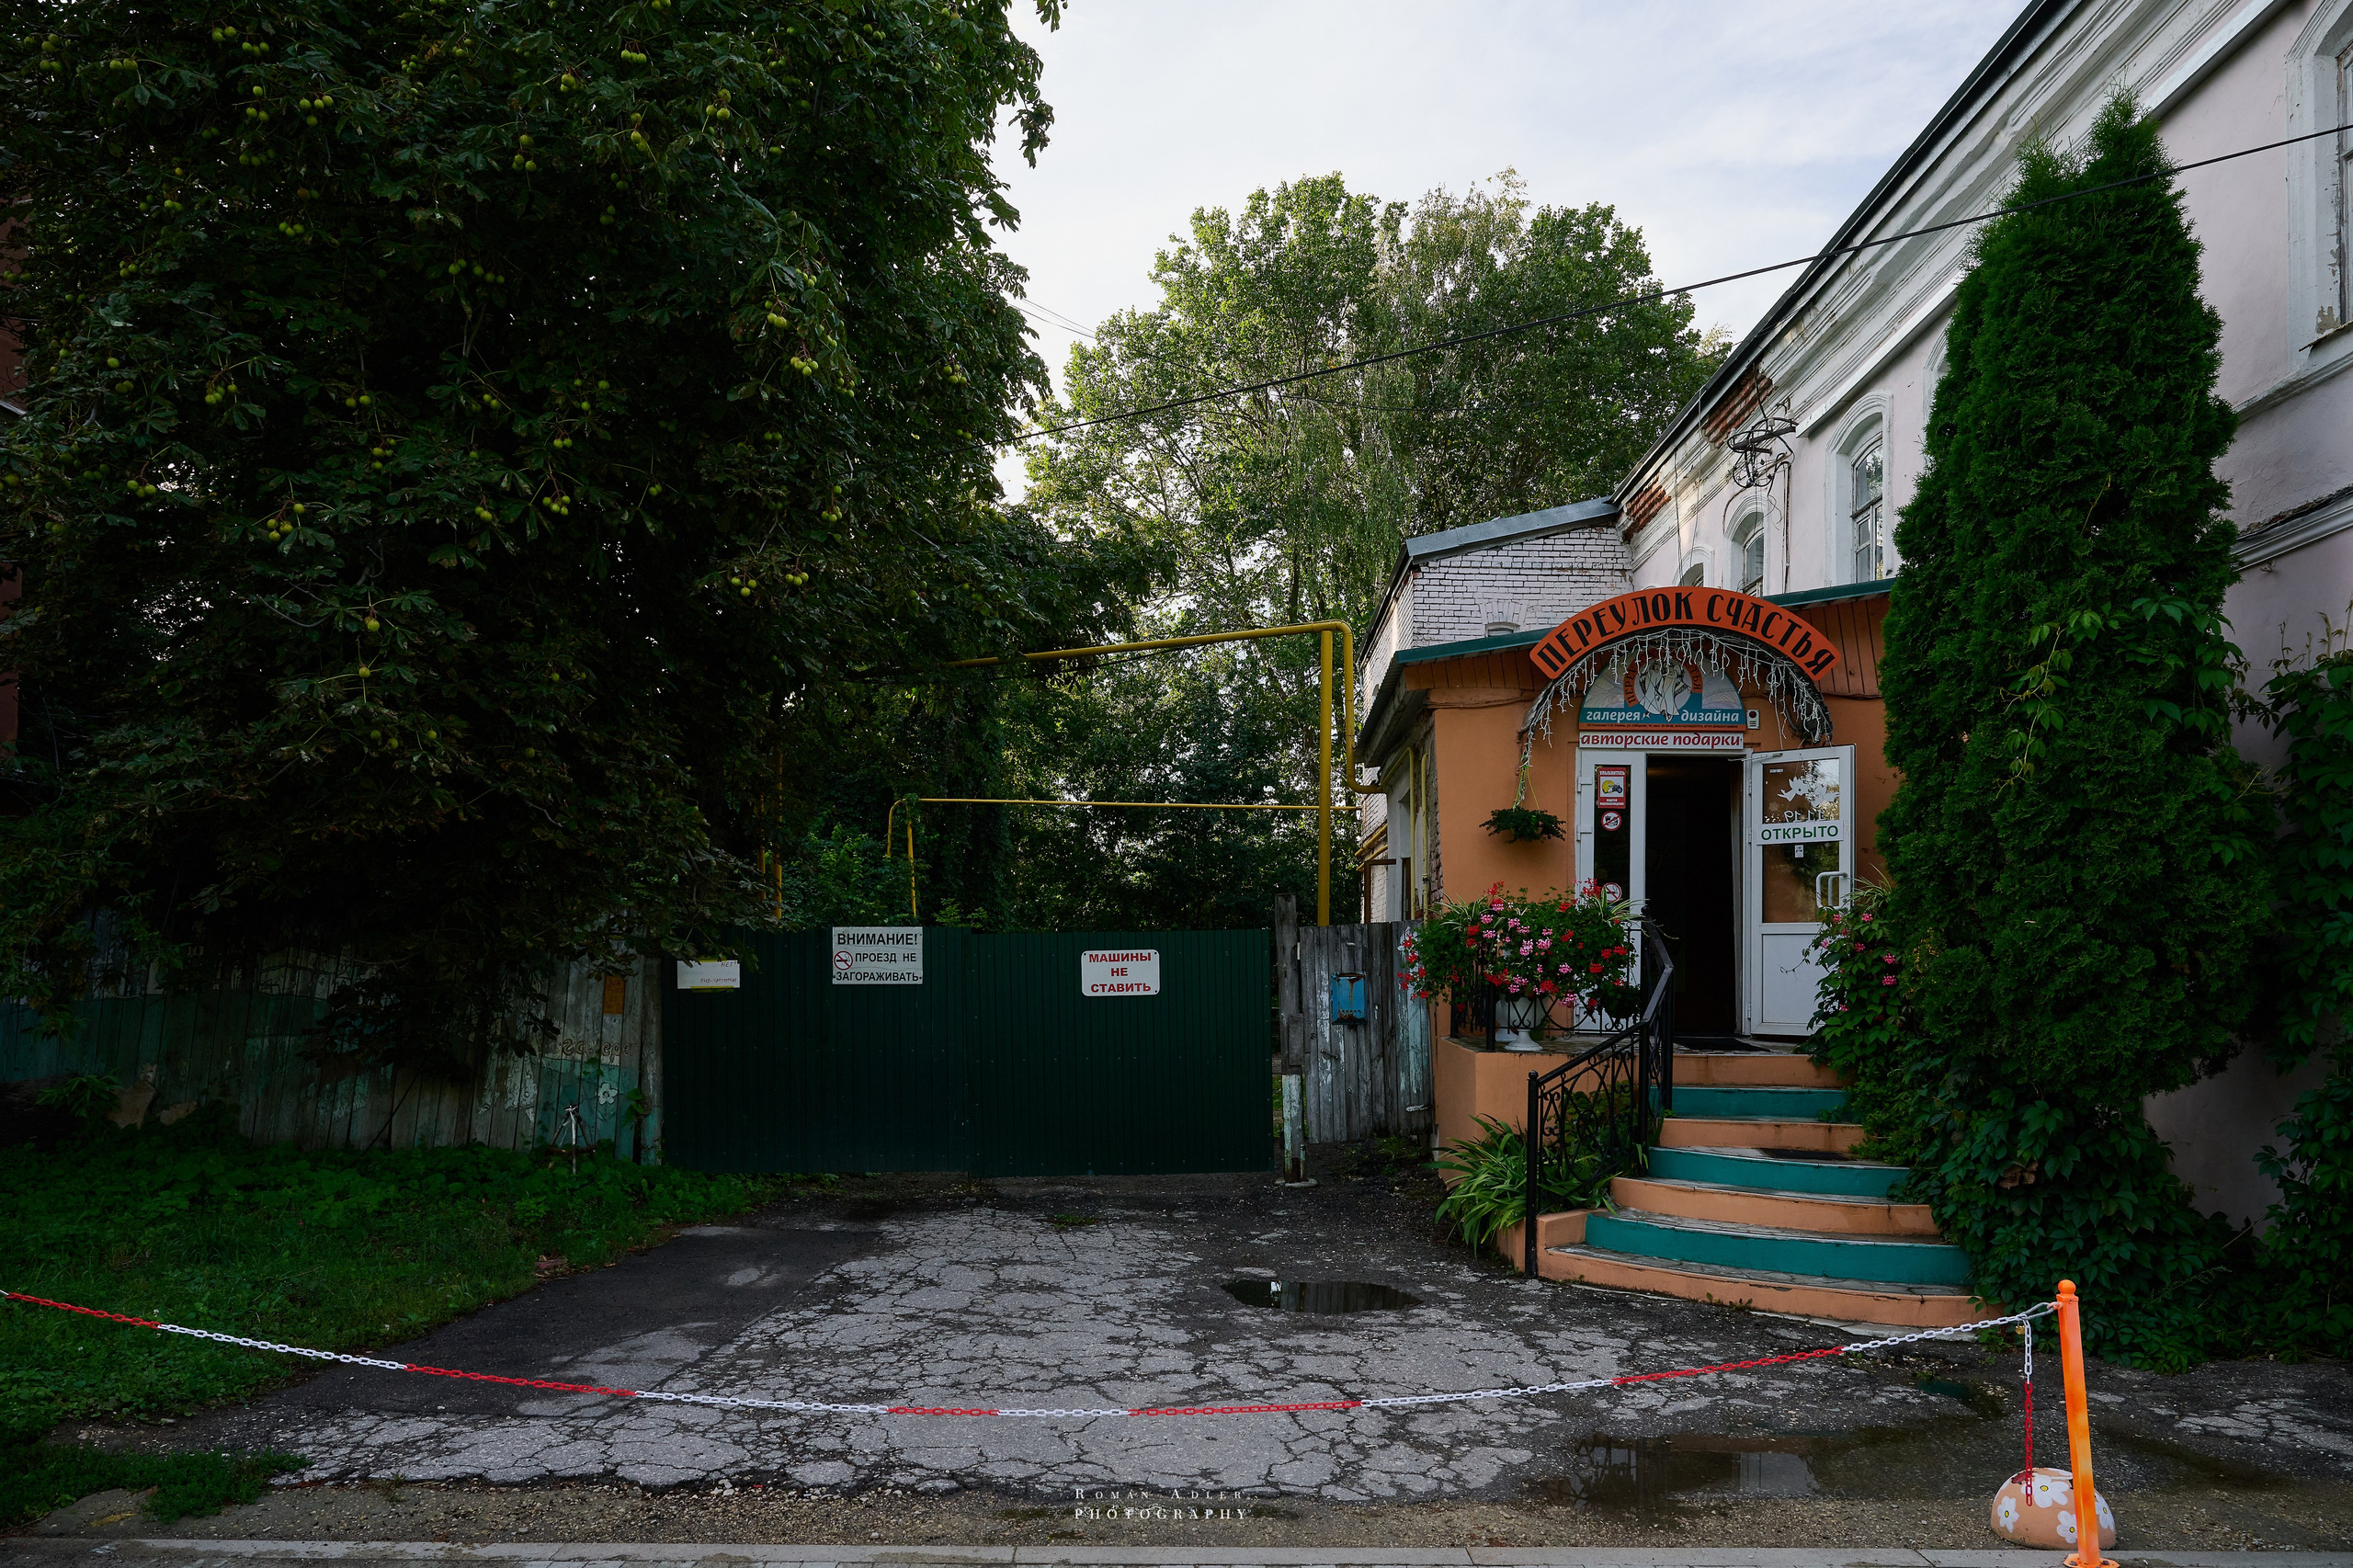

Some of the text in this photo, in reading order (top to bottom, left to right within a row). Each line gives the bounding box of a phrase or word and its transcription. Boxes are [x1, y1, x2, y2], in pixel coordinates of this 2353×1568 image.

[1537, 591, 1836, 676] ПЕРЕУЛОК СЧАСТЬЯ
[1586, 709, 1740, 723] галерея дизайна
[1580, 732, 1741, 749] авторские подарки
[1761, 825, 1838, 840] ОТКРЫТО
[837, 933, 917, 945] ВНИМАНИЕ!
[855, 952, 916, 963] ПРОЕЗД НЕ
[1088, 952, 1152, 963] МАШИНЫ
[835, 971, 919, 982] ЗАГОРАЖИВАТЬ
[1110, 967, 1129, 977] НЕ
[1090, 983, 1152, 993] СТАВИТЬ
